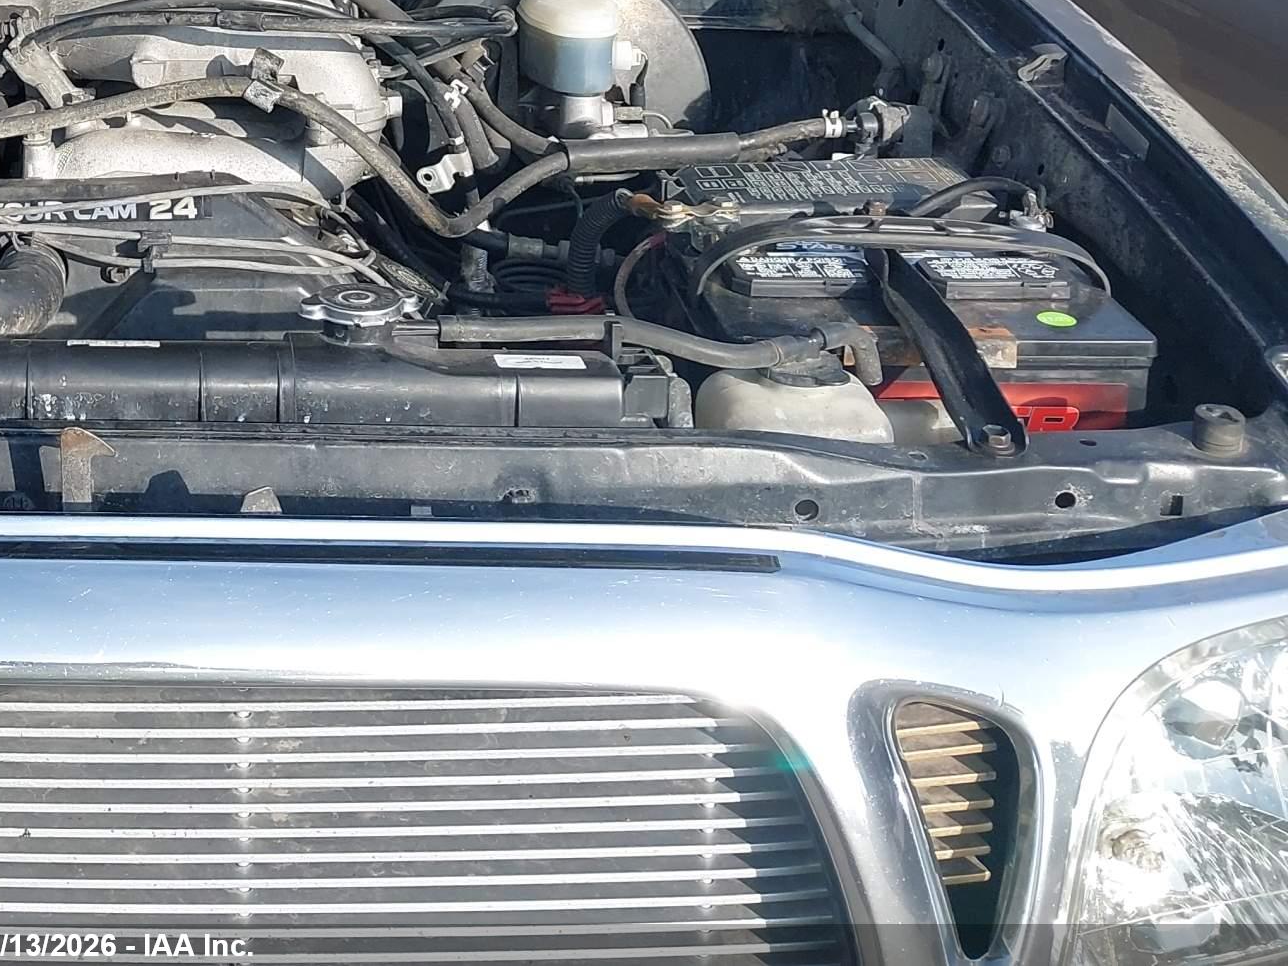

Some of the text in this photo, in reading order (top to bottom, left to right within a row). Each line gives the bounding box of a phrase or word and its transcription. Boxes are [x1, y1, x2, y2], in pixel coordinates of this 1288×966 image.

[74, 201, 137, 221] CAM
[149, 196, 198, 220] 24
[775, 240, 856, 251] STAR
